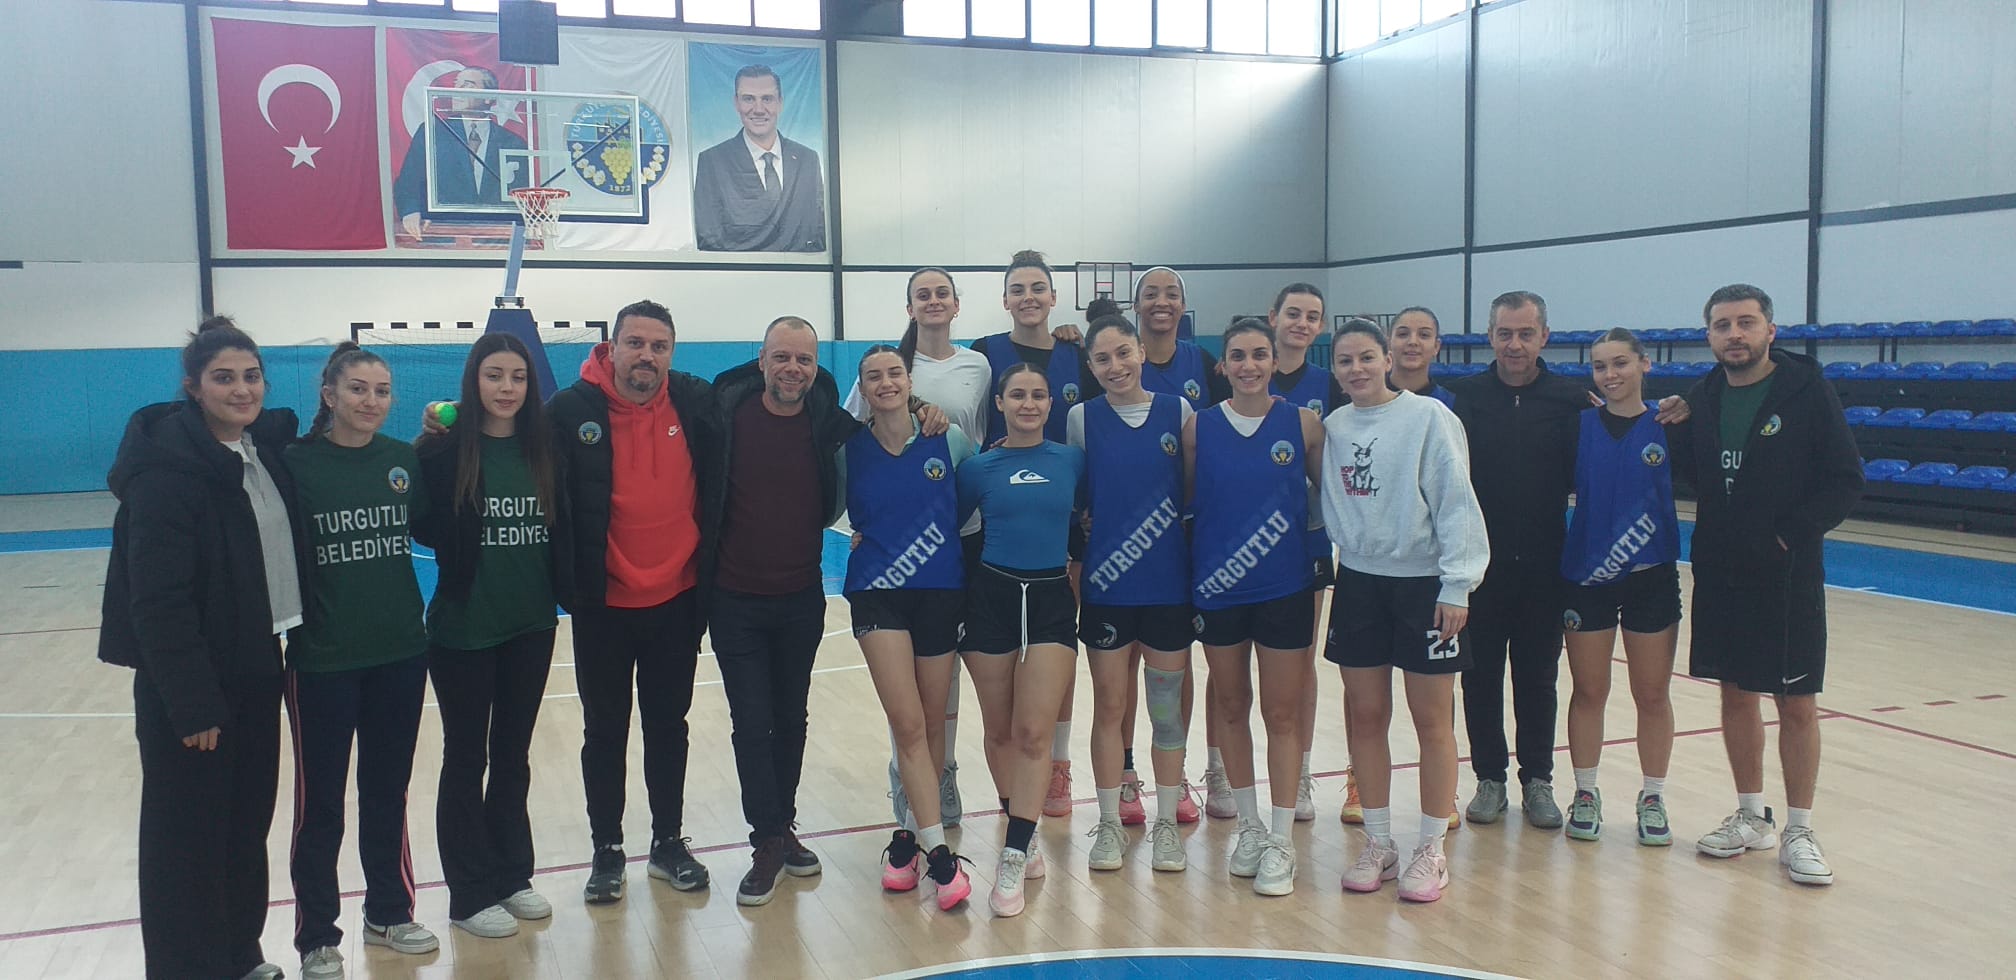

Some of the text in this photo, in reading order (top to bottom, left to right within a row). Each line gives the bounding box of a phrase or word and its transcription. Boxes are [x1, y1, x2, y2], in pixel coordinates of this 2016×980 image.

[313, 504, 408, 535] TURGUTLU
[1088, 496, 1179, 593] TURGUTLU
[316, 530, 411, 566] BELEDİYES
[864, 521, 946, 591] RGUTLU
[1580, 512, 1657, 586] RGUTLU
[1426, 629, 1460, 660] 23
